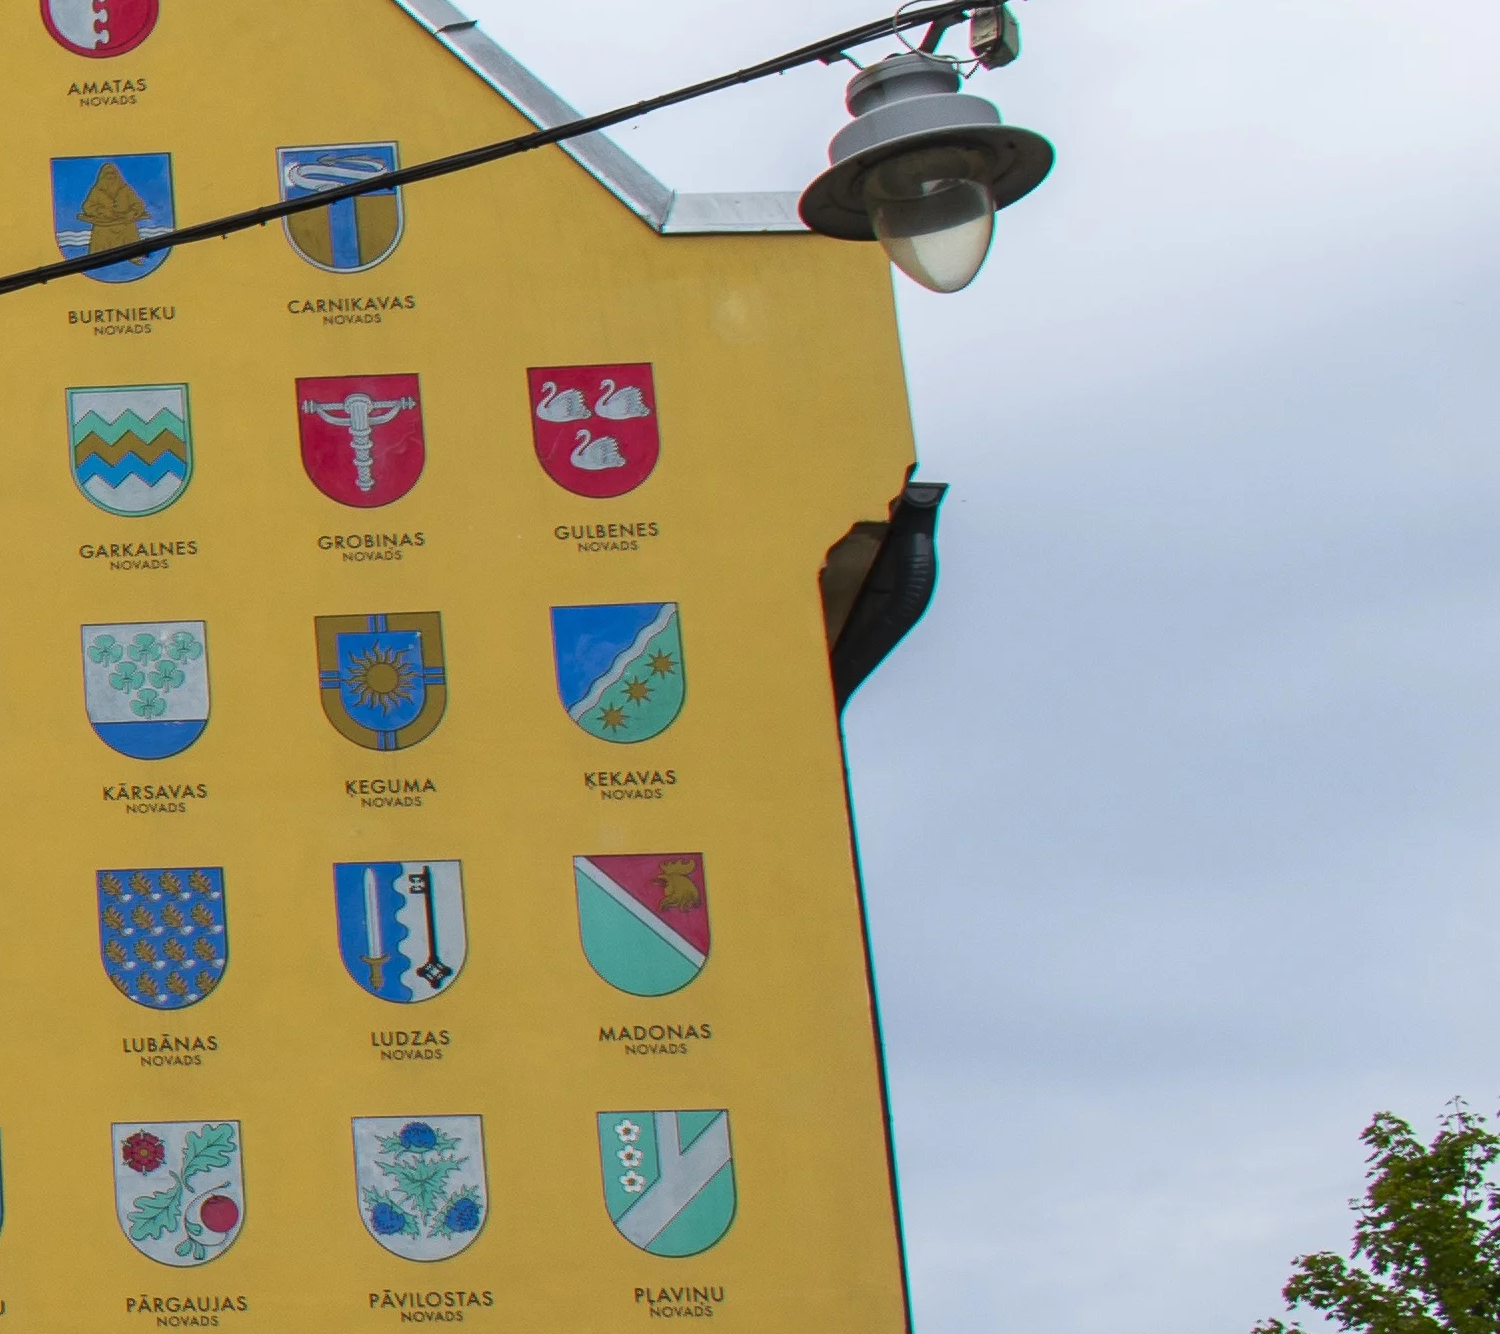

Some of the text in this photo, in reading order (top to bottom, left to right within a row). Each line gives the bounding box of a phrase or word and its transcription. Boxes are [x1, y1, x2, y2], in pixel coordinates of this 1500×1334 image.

[66, 76, 148, 96] AMATAS
[286, 294, 416, 315] CARNIKAVAS
[67, 305, 176, 325] BURTNIEKU
[554, 521, 660, 541] GULBENES
[78, 540, 198, 559] GARKALNES
[317, 531, 426, 554] GROBIŅAS
[344, 778, 438, 800] ĶEGUMA
[583, 769, 678, 793] ĶEKAVAS
[102, 782, 208, 801] KĀRSAVAS
[370, 1029, 450, 1047] LUDZAS
[598, 1023, 712, 1042] MADONAS
[122, 1033, 218, 1054] LUBĀNAS
[126, 1293, 248, 1313] PĀRGAUJAS
[368, 1289, 494, 1309] PĀVILOSTAS
[634, 1285, 725, 1309] PĻAVIŅU
